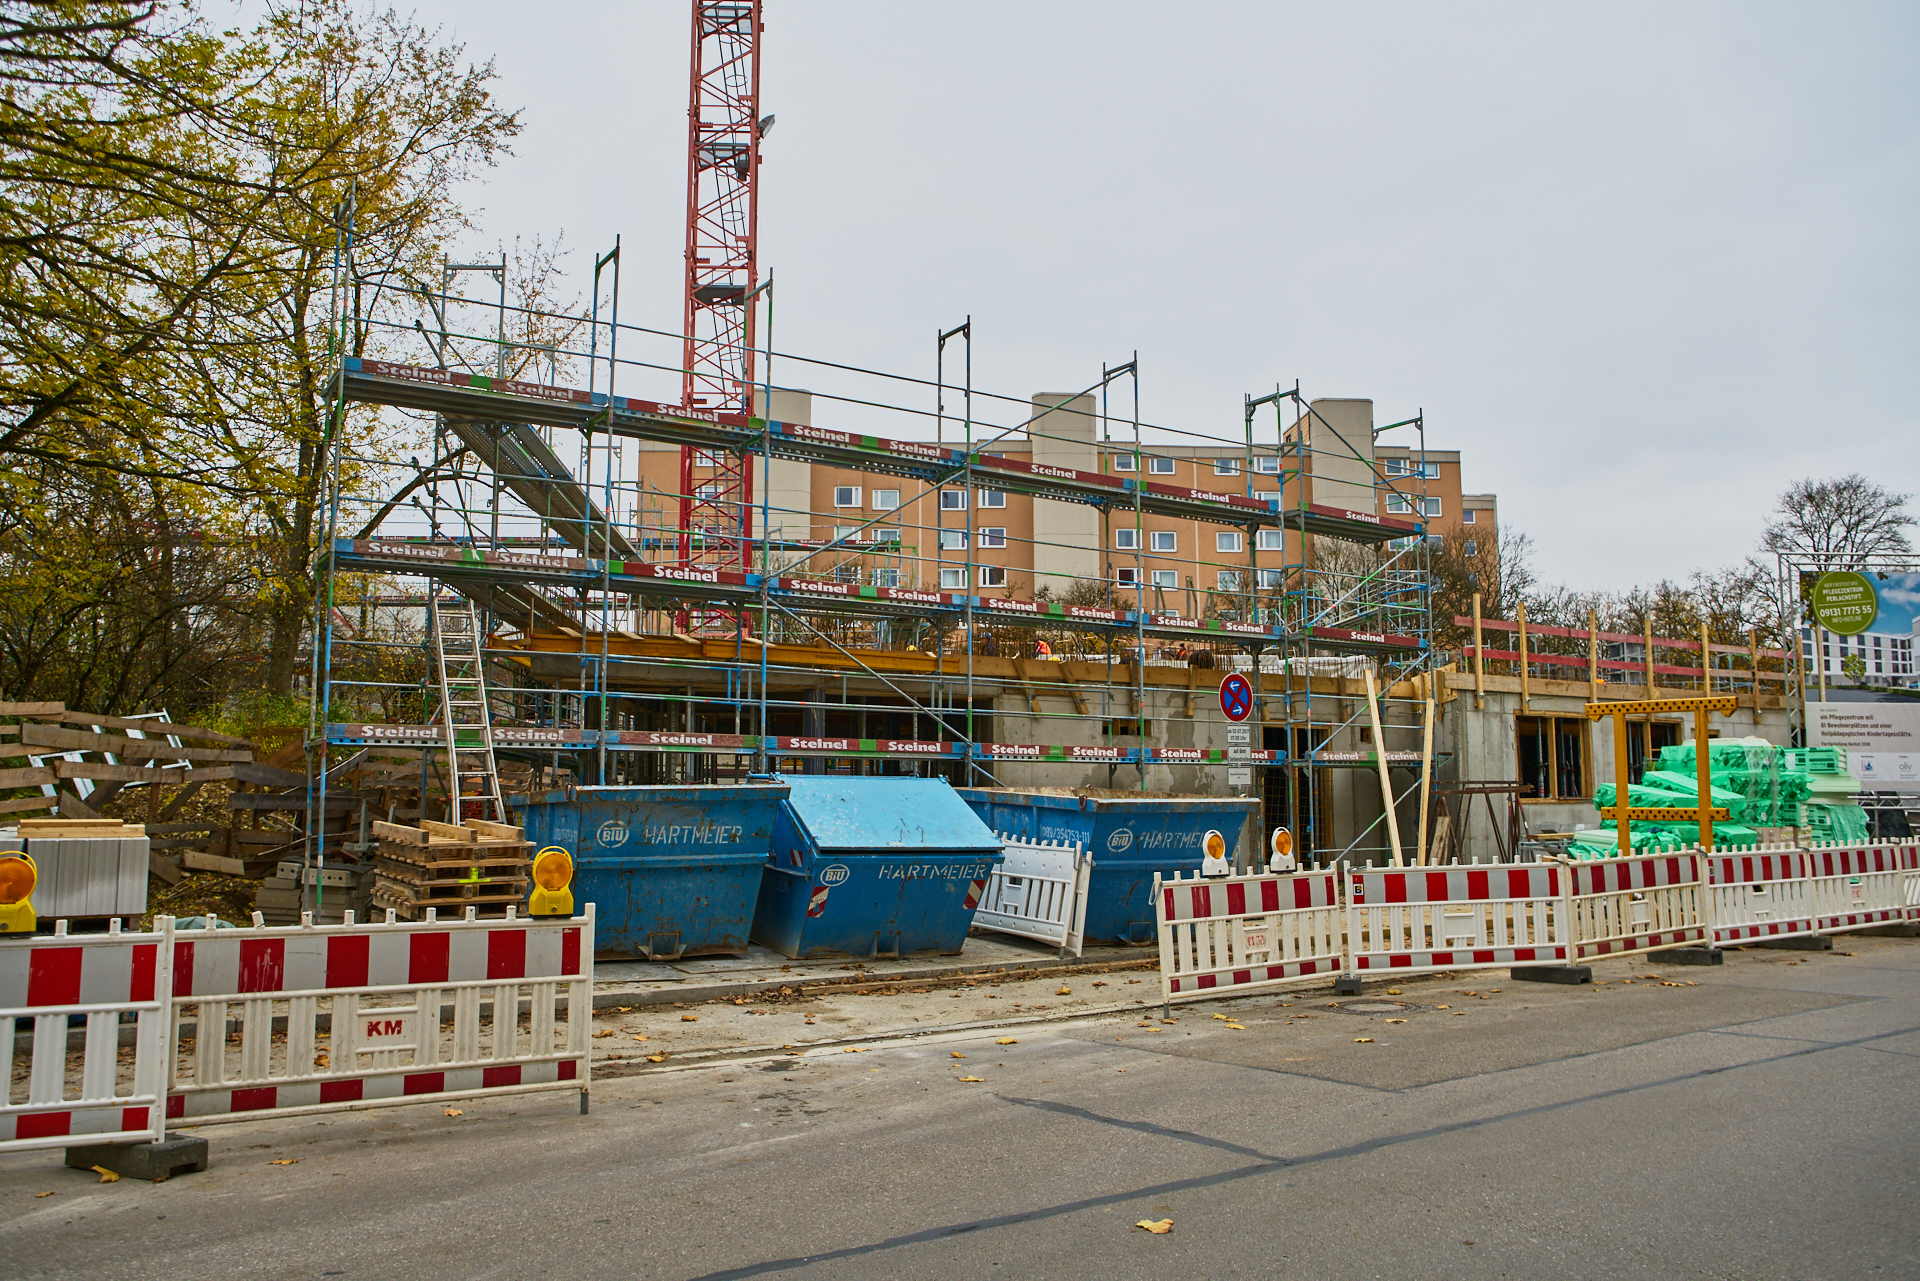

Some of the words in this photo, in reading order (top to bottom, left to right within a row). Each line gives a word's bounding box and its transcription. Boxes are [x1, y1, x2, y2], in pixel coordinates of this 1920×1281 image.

[377, 363, 451, 383] Steinel
[505, 381, 574, 400] Steinel
[657, 404, 719, 422] Steinel
[794, 425, 850, 443] Steinel
[889, 441, 941, 457] Steinel
[1031, 464, 1077, 480] Steinel
[1190, 490, 1230, 502] Steinel
[1346, 511, 1380, 524] Steinel
[368, 542, 444, 558] Steinel
[499, 554, 569, 568] Steinel
[654, 565, 718, 582] Steinel
[791, 580, 847, 594] Steinel
[1822, 586, 1864, 595] PFLEGEZENTRUM
[888, 588, 941, 603] Steinel
[1826, 593, 1862, 602] PERLACHSTIFT
[989, 599, 1037, 612] Steinel
[1820, 608, 1841, 617] 09131
[1842, 606, 1861, 615] 7775
[1861, 605, 1872, 613] 55
[1071, 607, 1116, 620] Steinel
[1157, 616, 1198, 627] Steinel
[1226, 622, 1264, 633] Steinel
[1350, 631, 1385, 643] Steinel
[361, 725, 438, 739] Steinel
[494, 728, 564, 741] Steinel
[650, 733, 713, 745] Steinel
[790, 738, 848, 750] Steinel
[888, 741, 941, 752] Steinel
[992, 744, 1040, 755] Steinel
[1073, 746, 1118, 757] Steinel
[1160, 748, 1201, 758] Steinel
[1323, 752, 1359, 760] Steinel
[1385, 752, 1418, 760] Steinel
[1899, 762, 1912, 770] oliv
[644, 825, 742, 844] HARTMEIER
[878, 864, 987, 880] HARTMEIER
[367, 1020, 402, 1037] KM
